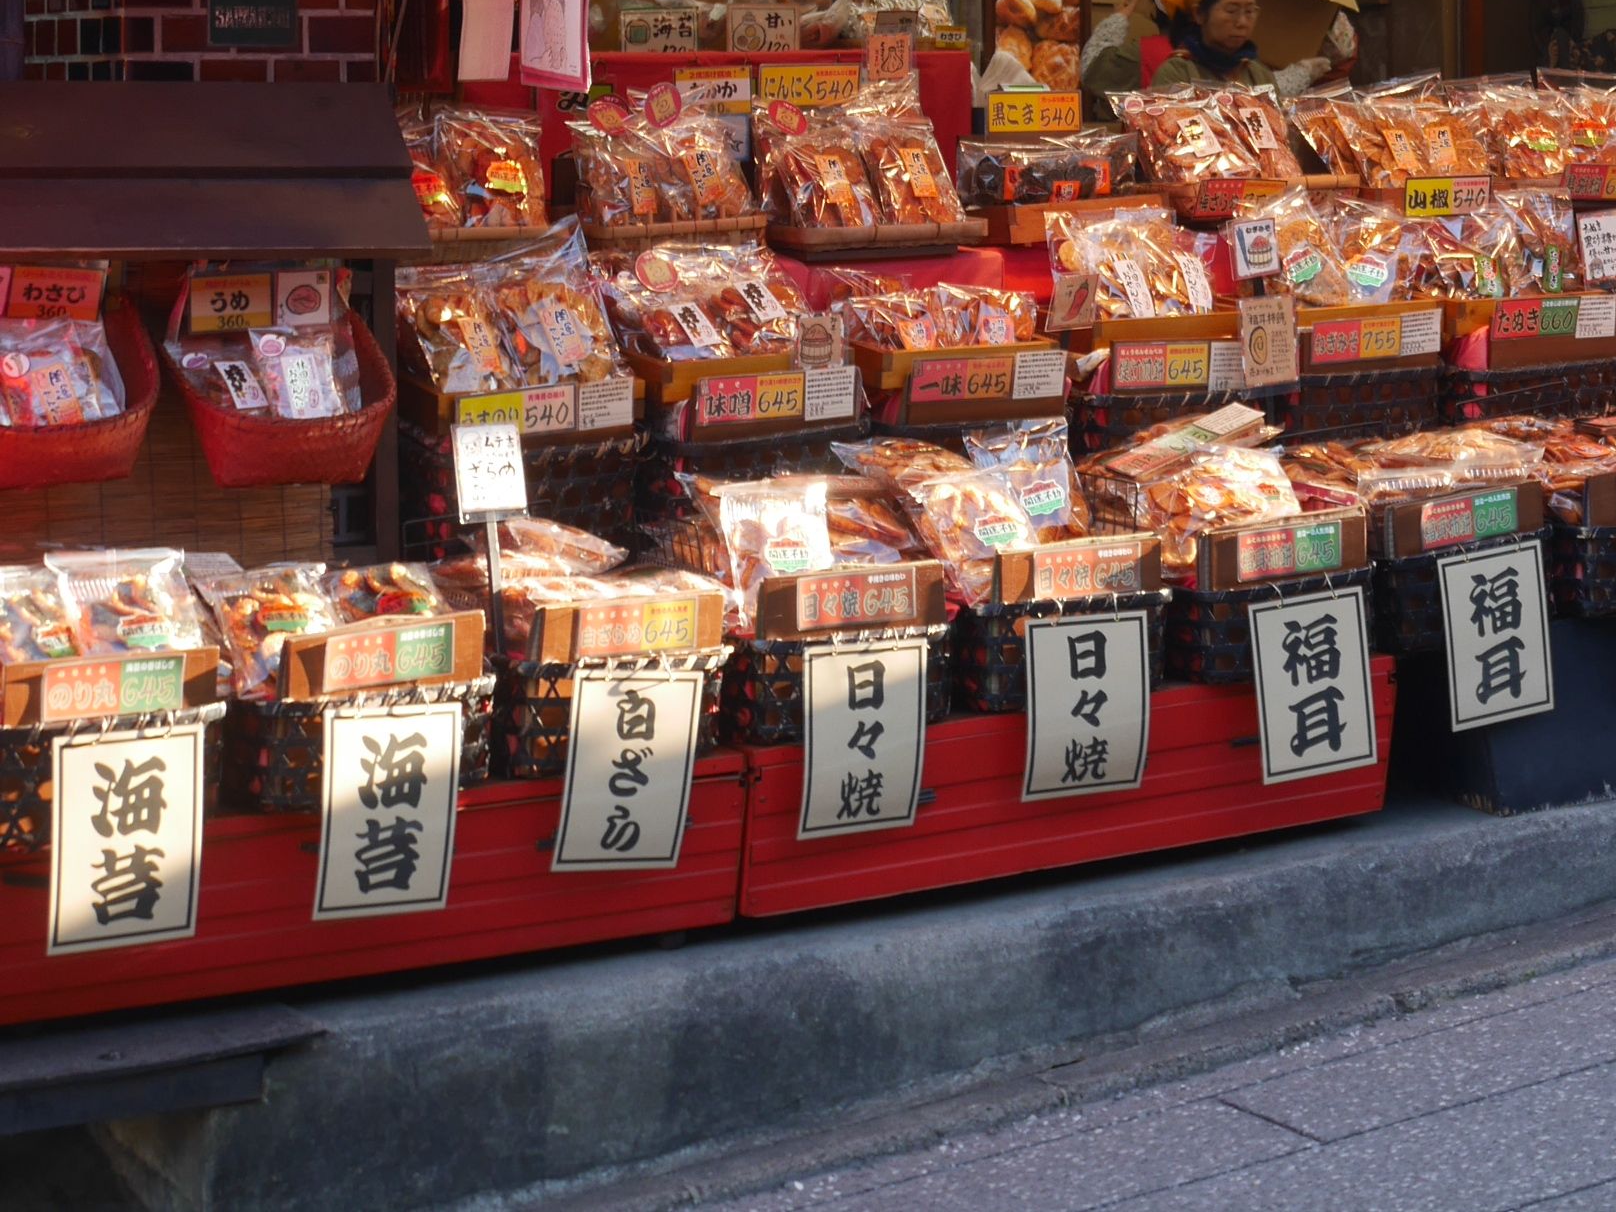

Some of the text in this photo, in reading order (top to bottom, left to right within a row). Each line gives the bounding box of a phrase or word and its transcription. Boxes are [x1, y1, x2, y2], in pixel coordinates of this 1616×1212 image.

[764, 74, 854, 102] にんにく 540
[1039, 107, 1075, 127] 540
[1408, 188, 1486, 209] 山椒 540
[23, 282, 87, 305] わさび
[210, 290, 250, 313] うめ
[217, 314, 245, 329] 360
[1497, 306, 1540, 333] たぬき
[1540, 313, 1575, 330] 660
[1314, 331, 1359, 356] ねぎみそ
[1363, 330, 1397, 351] 755
[1168, 359, 1203, 380] 645
[920, 373, 961, 398] 一味
[967, 373, 1007, 396] 645
[525, 402, 569, 428] 540
[705, 390, 751, 417] 味噌
[758, 389, 798, 413] 645
[1474, 506, 1512, 533] 645
[768, 548, 809, 560] 開運不動
[1296, 540, 1335, 567] 645
[1039, 561, 1137, 593] 日々焼 645
[803, 587, 911, 622] 日々焼 645
[581, 618, 690, 648] 白ざらめ 645
[1470, 566, 1526, 706] 福耳
[330, 643, 448, 679] のり丸 645
[49, 674, 177, 710] のり丸 645
[1282, 612, 1348, 758] 福耳
[1060, 630, 1110, 785] 日々焼
[836, 659, 887, 821] 日々焼
[600, 689, 657, 853] 白ざら
[354, 731, 428, 895] 海苔
[91, 755, 167, 926] 海苔
